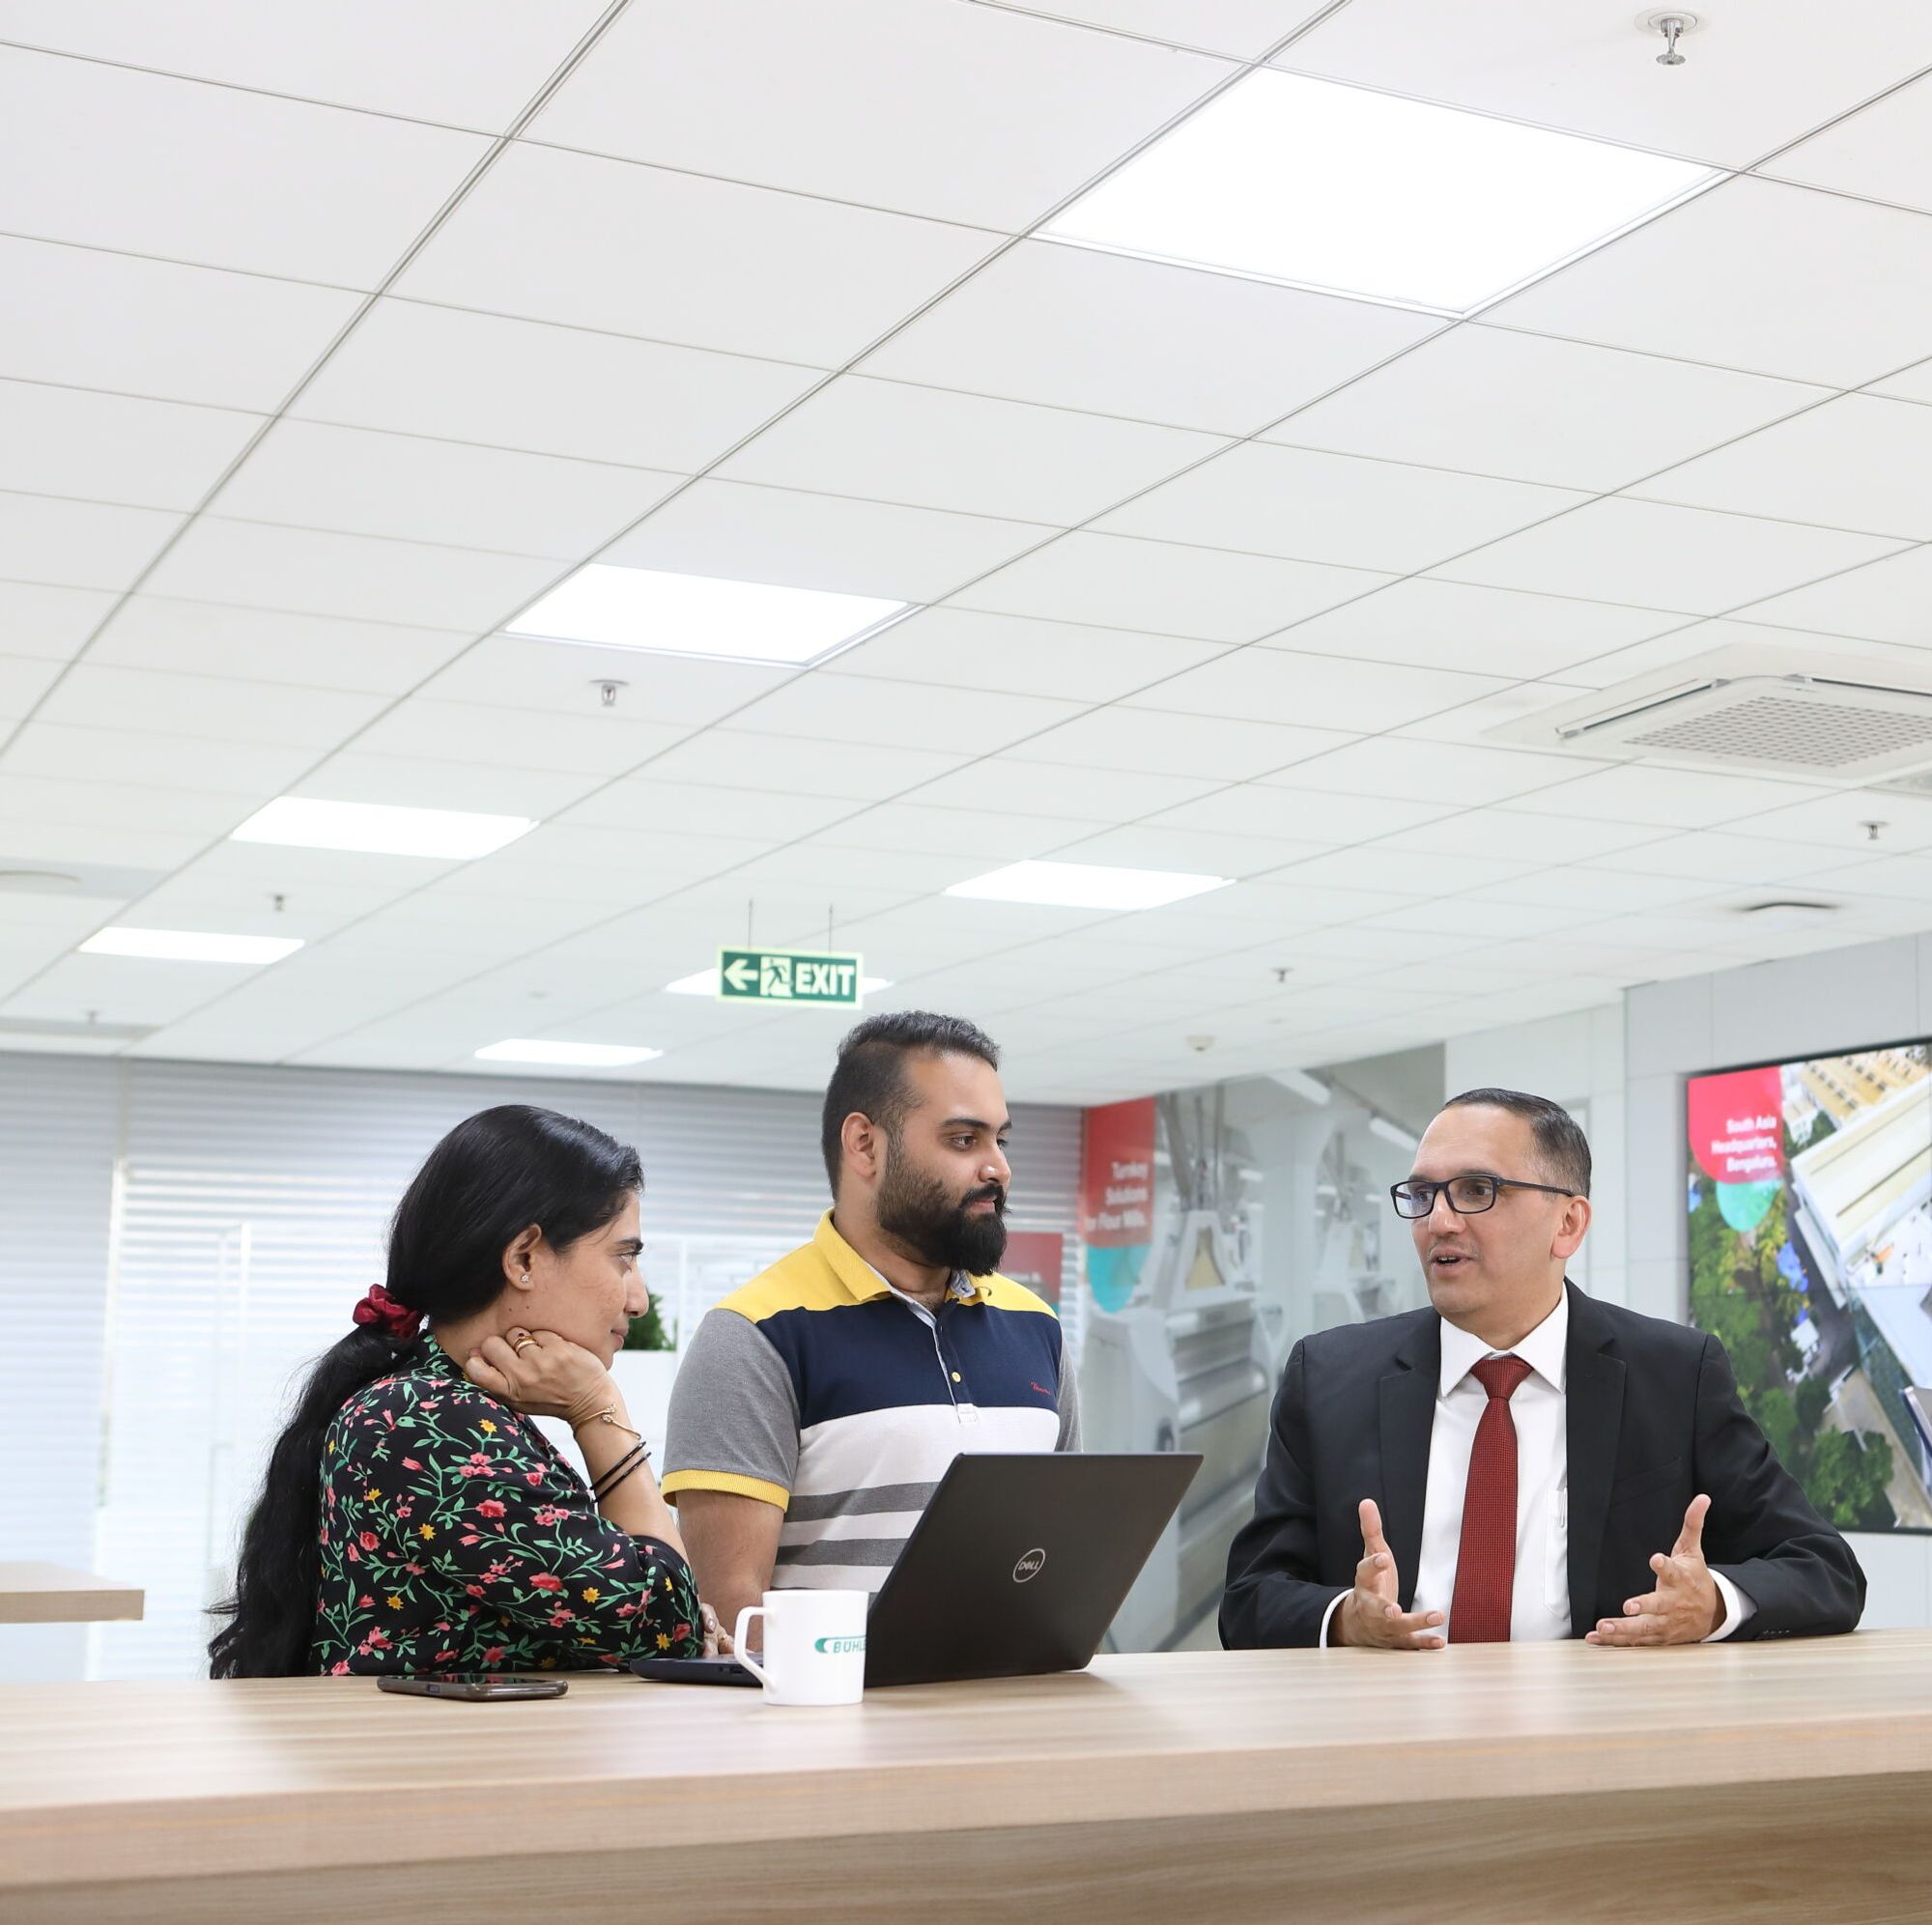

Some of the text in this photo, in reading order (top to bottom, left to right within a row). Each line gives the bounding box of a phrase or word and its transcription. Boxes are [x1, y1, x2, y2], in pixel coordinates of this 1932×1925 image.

[795, 962, 854, 996] EXIT
[1726, 1115, 1776, 1134] South Asia
[1018, 1560, 1039, 1571] DELL
